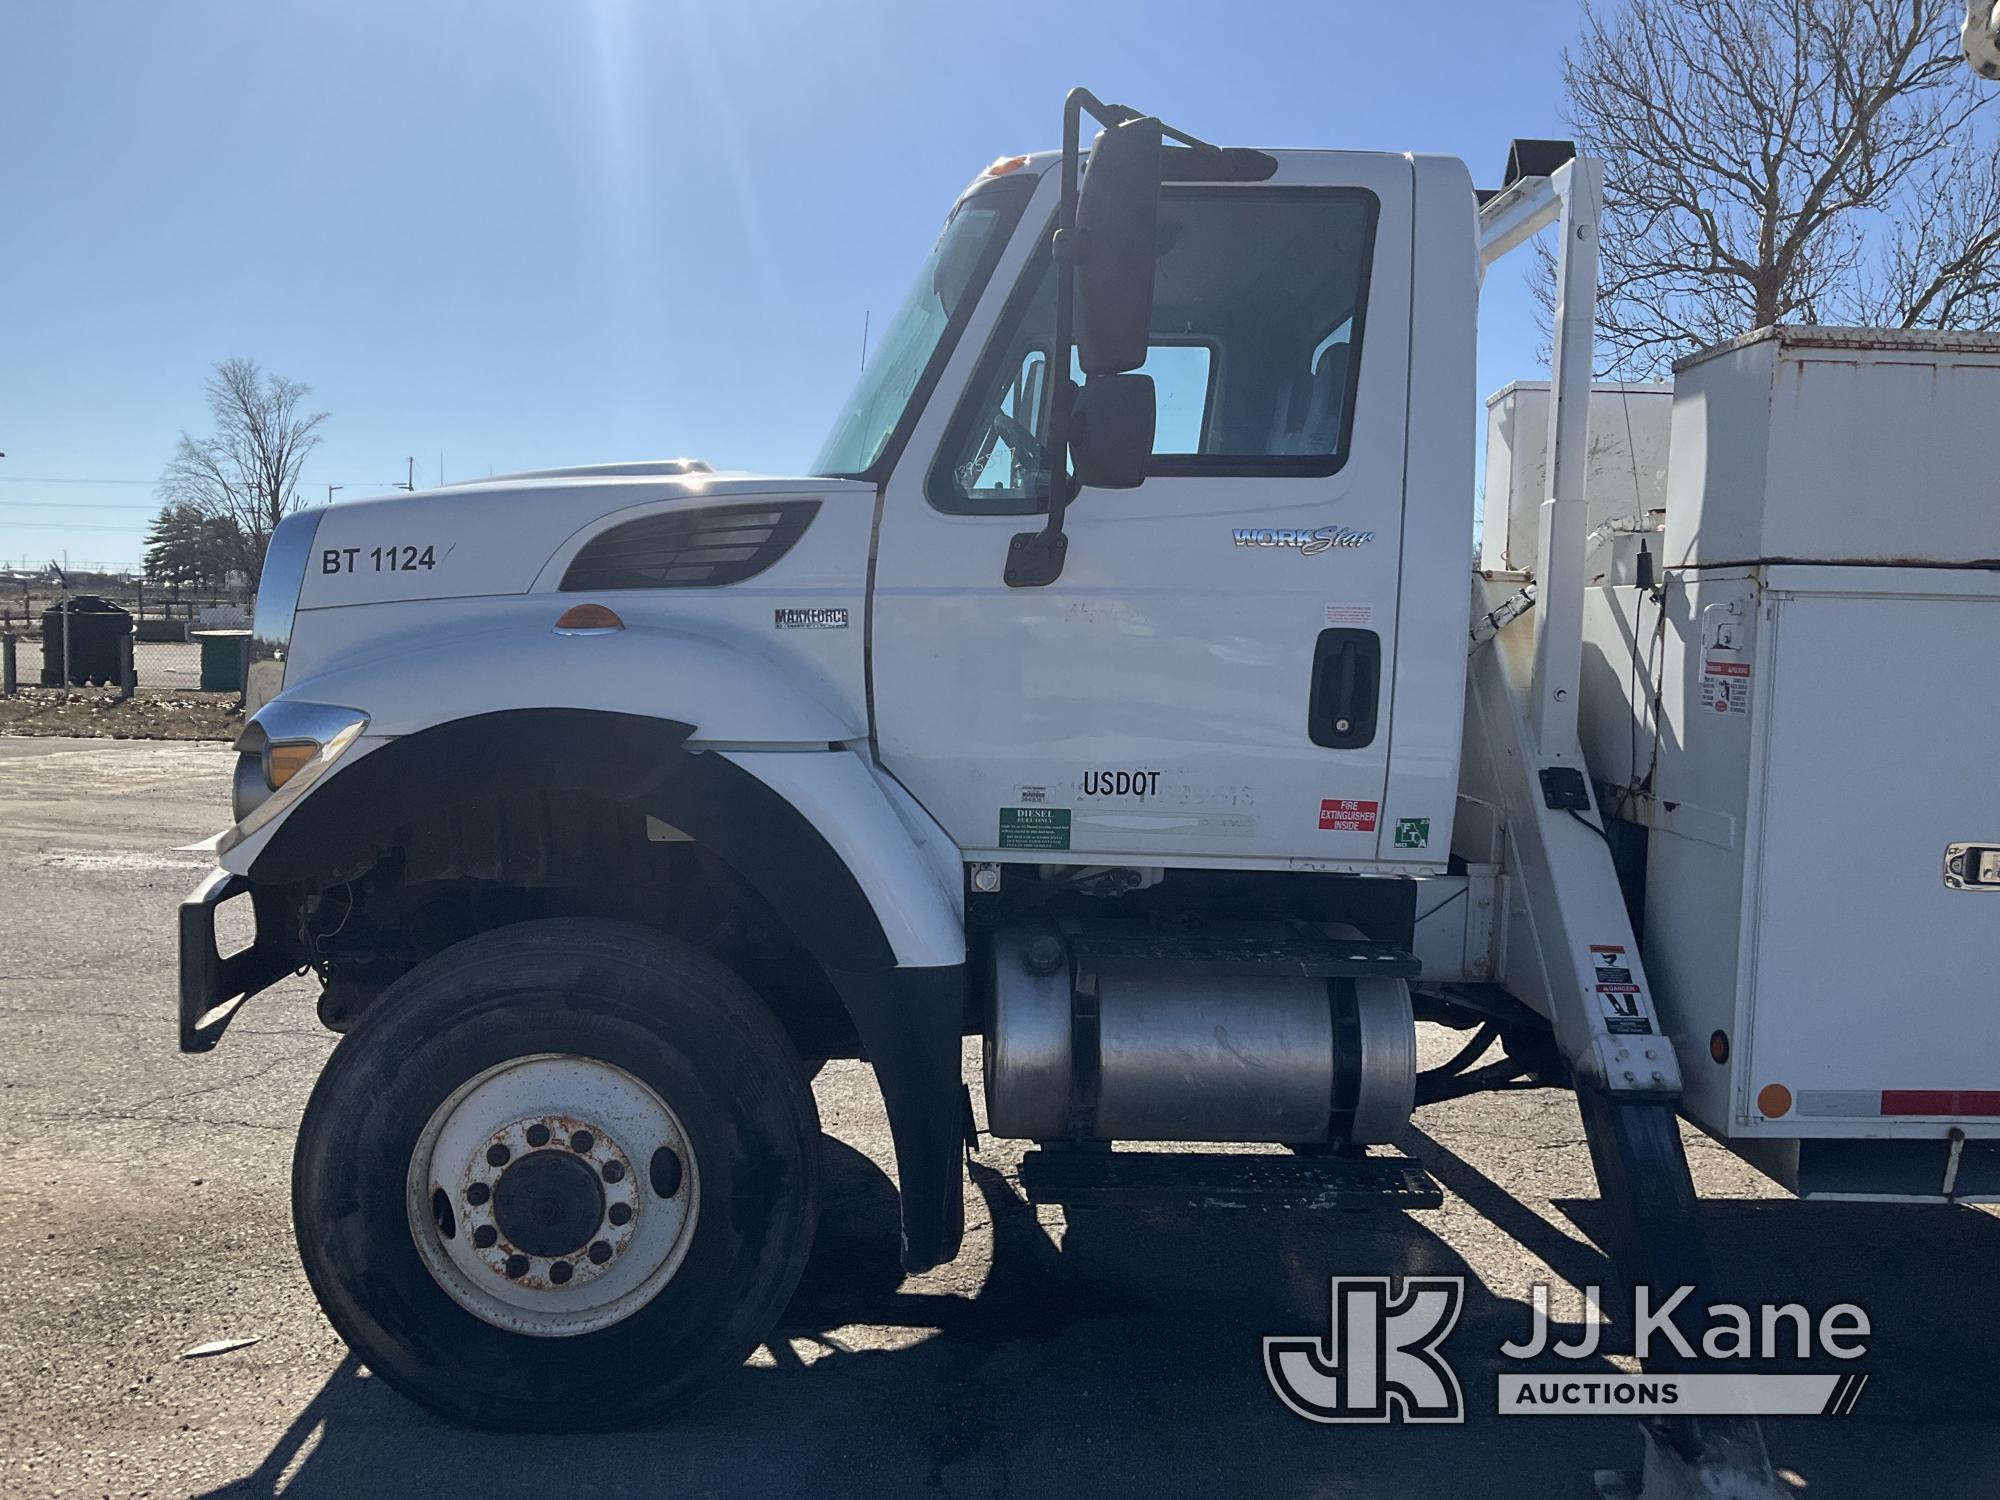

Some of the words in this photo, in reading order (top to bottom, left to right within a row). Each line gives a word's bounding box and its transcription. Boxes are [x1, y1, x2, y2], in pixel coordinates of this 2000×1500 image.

[323, 548, 360, 574] BT
[370, 546, 436, 571] 1124
[1084, 771, 1160, 796] USDOT
[1341, 801, 1358, 810] FIRE
[1017, 809, 1055, 818] DIESEL
[1320, 810, 1376, 821] EXTINGUISHER
[1334, 821, 1359, 830] INSIDE
